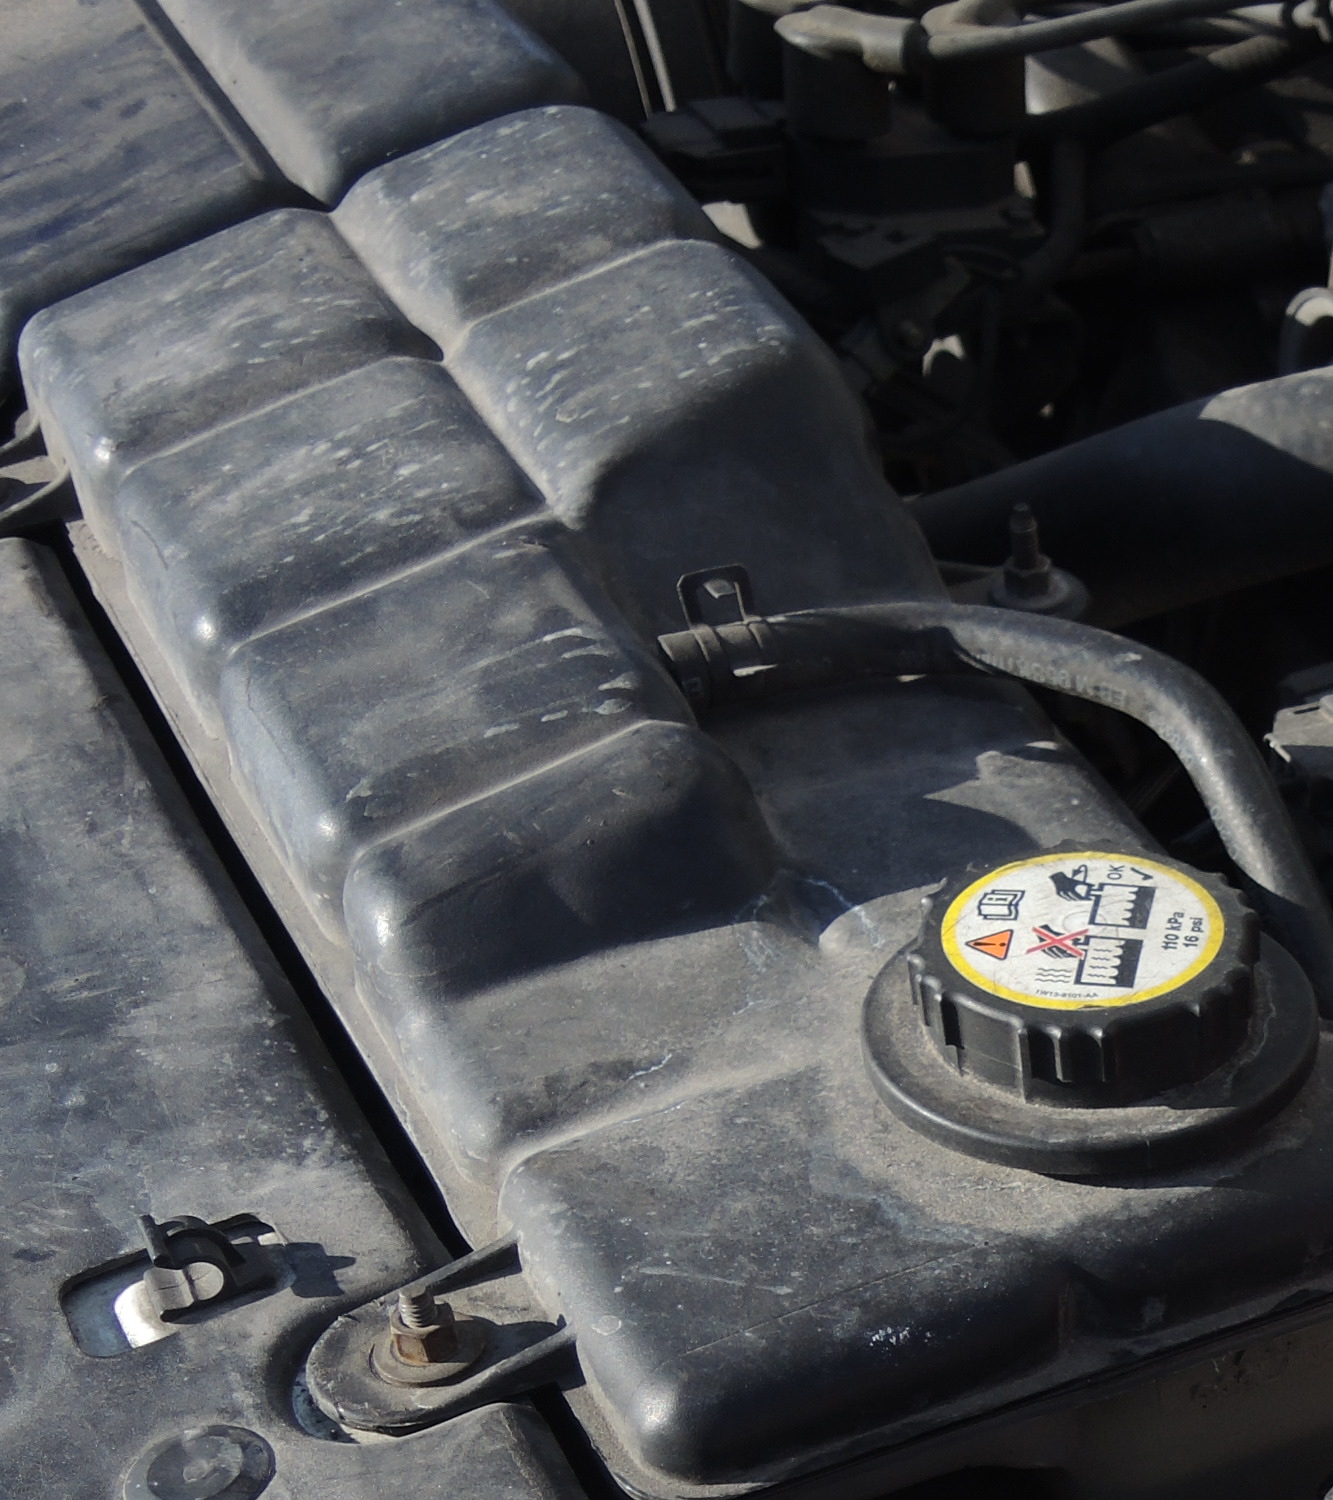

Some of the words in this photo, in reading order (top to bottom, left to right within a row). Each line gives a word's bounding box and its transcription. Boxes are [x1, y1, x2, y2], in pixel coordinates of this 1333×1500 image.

[1107, 864, 1126, 881] OK
[1166, 911, 1185, 929] kPa
[1190, 917, 1204, 932] psi
[1161, 930, 1179, 951] 110
[1183, 934, 1199, 949] 16
